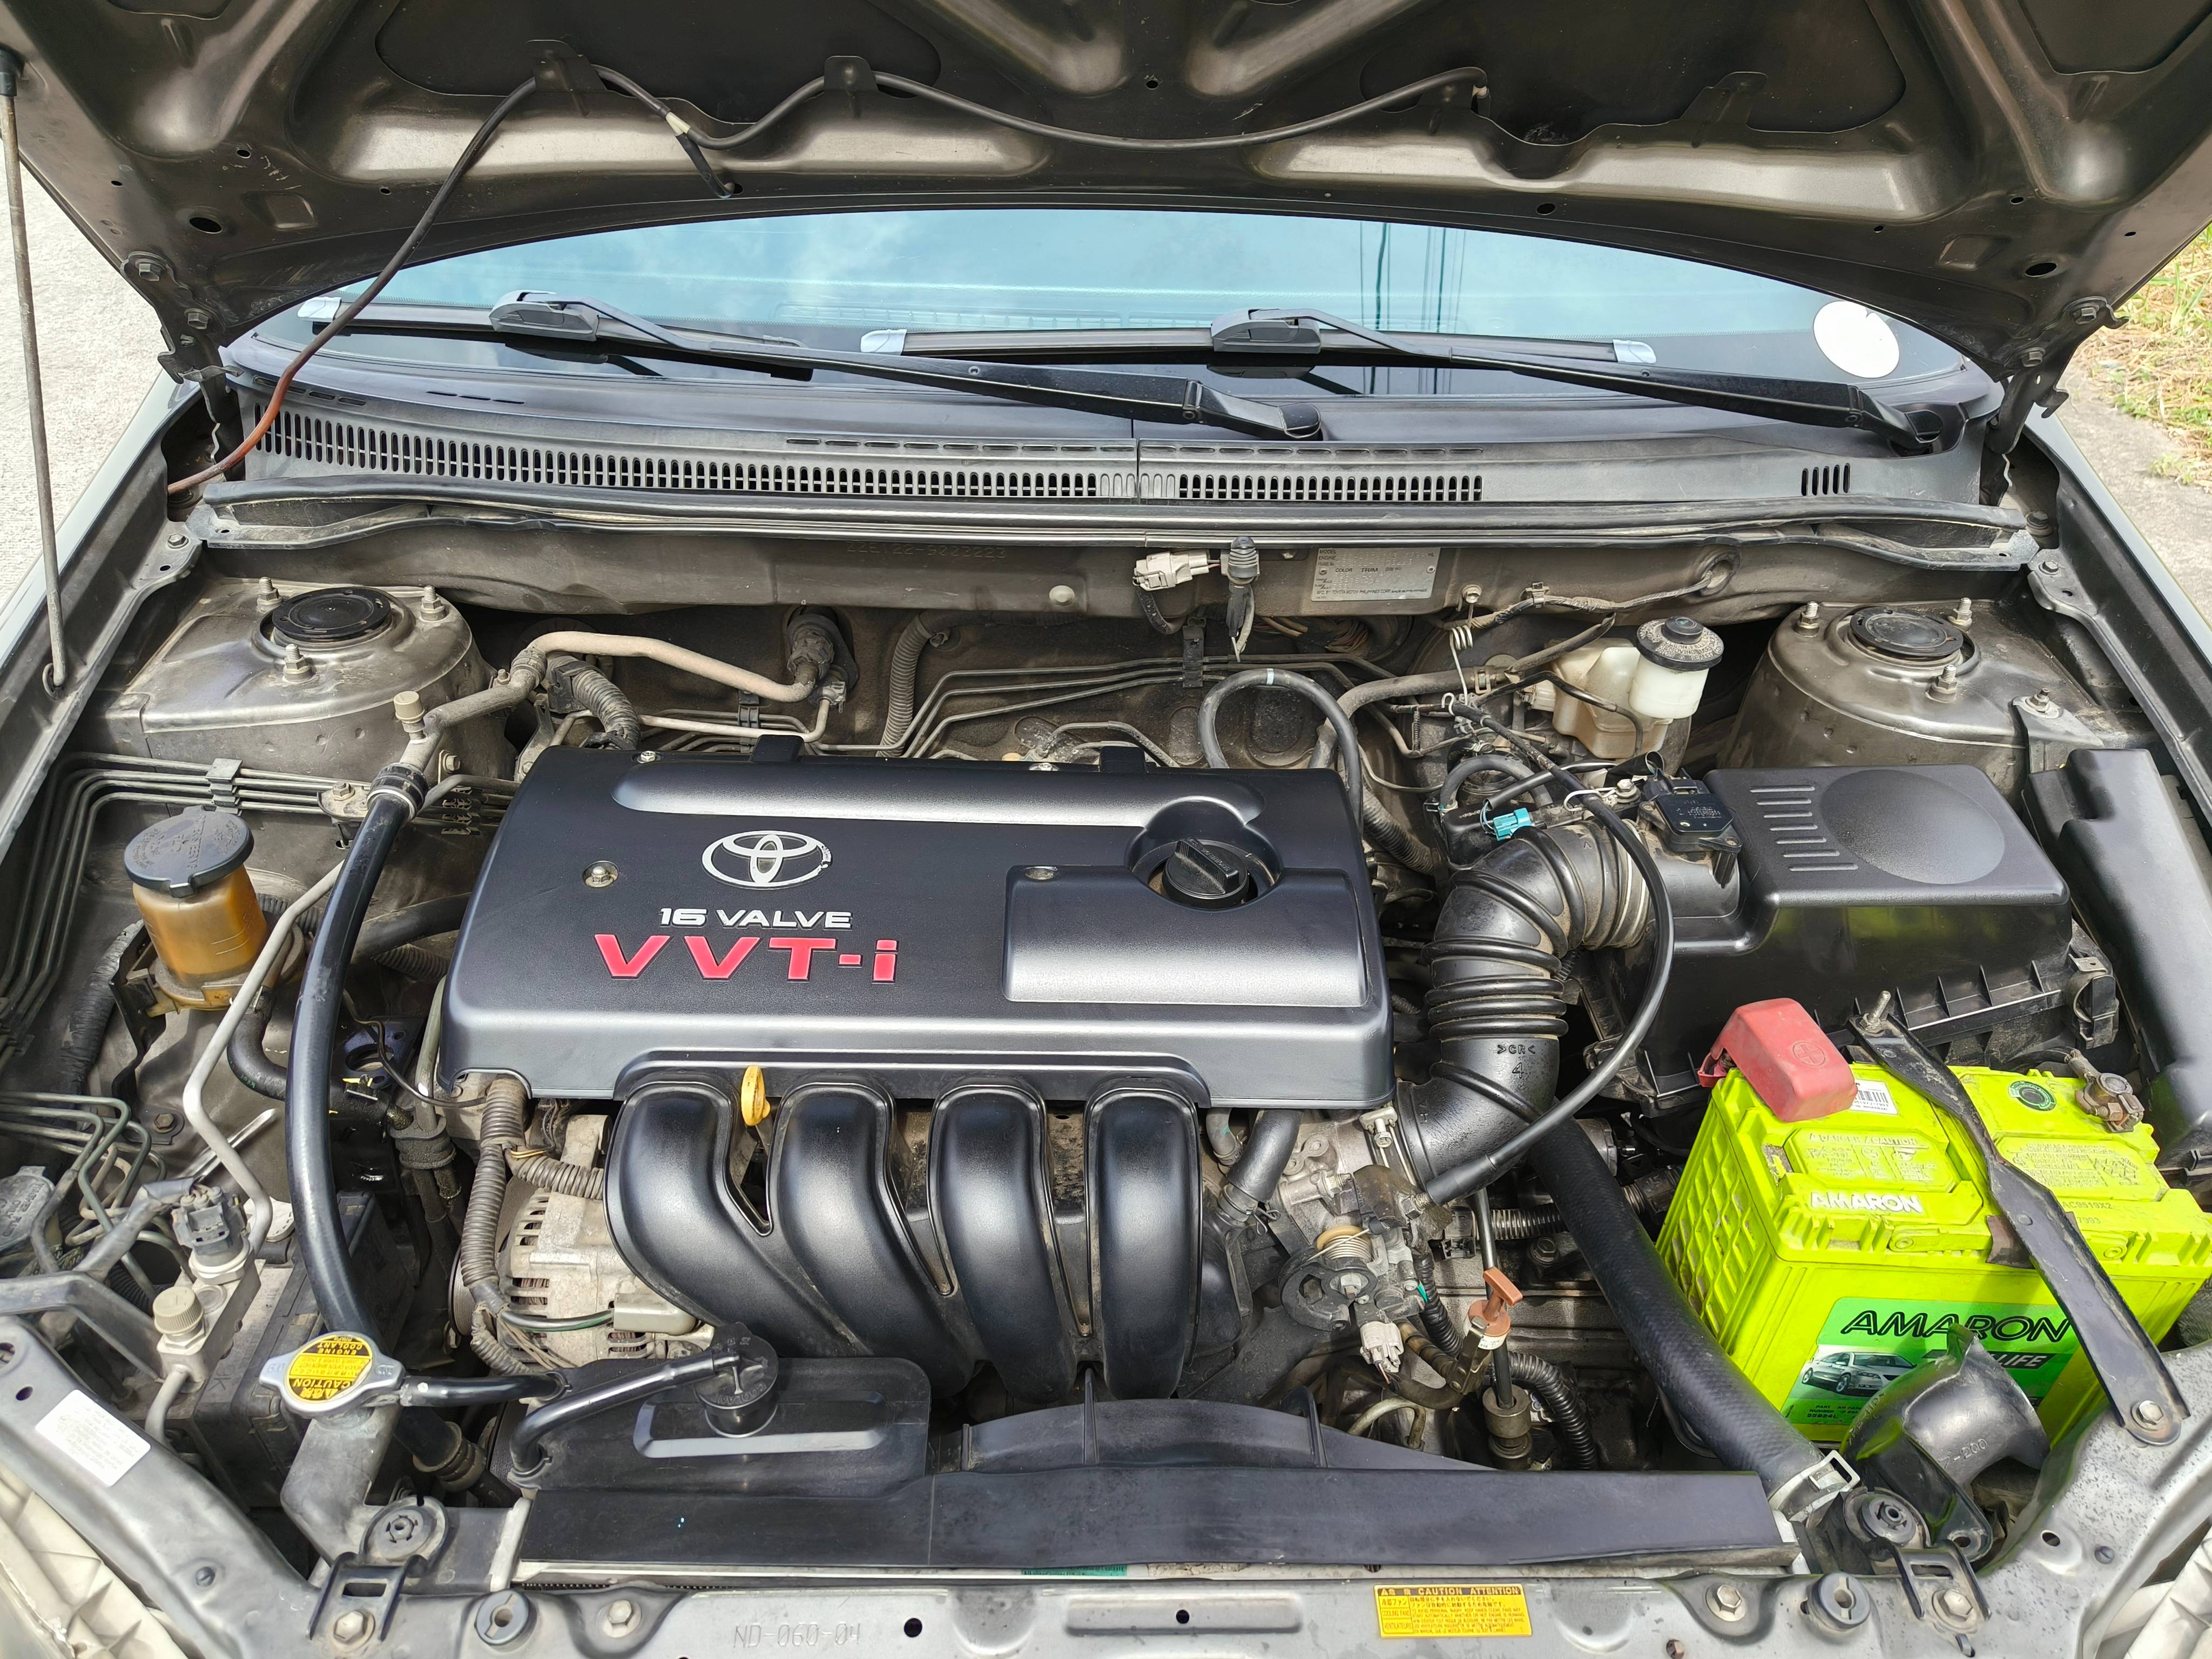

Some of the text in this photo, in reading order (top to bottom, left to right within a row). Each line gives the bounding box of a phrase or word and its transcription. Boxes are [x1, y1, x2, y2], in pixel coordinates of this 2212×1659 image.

[659, 908, 853, 929] 16 VALVE
[595, 934, 899, 983] VVT-i
[1512, 1062, 1525, 1079] 4
[1810, 1191, 1924, 1213] AMARON
[1840, 1309, 2070, 1343] AMARON
[318, 1341, 363, 1350] COOLANT
[293, 1378, 351, 1388] CAUTION
[1418, 1588, 1462, 1596] CAUTION
[1470, 1587, 1520, 1595] ATTENTION
